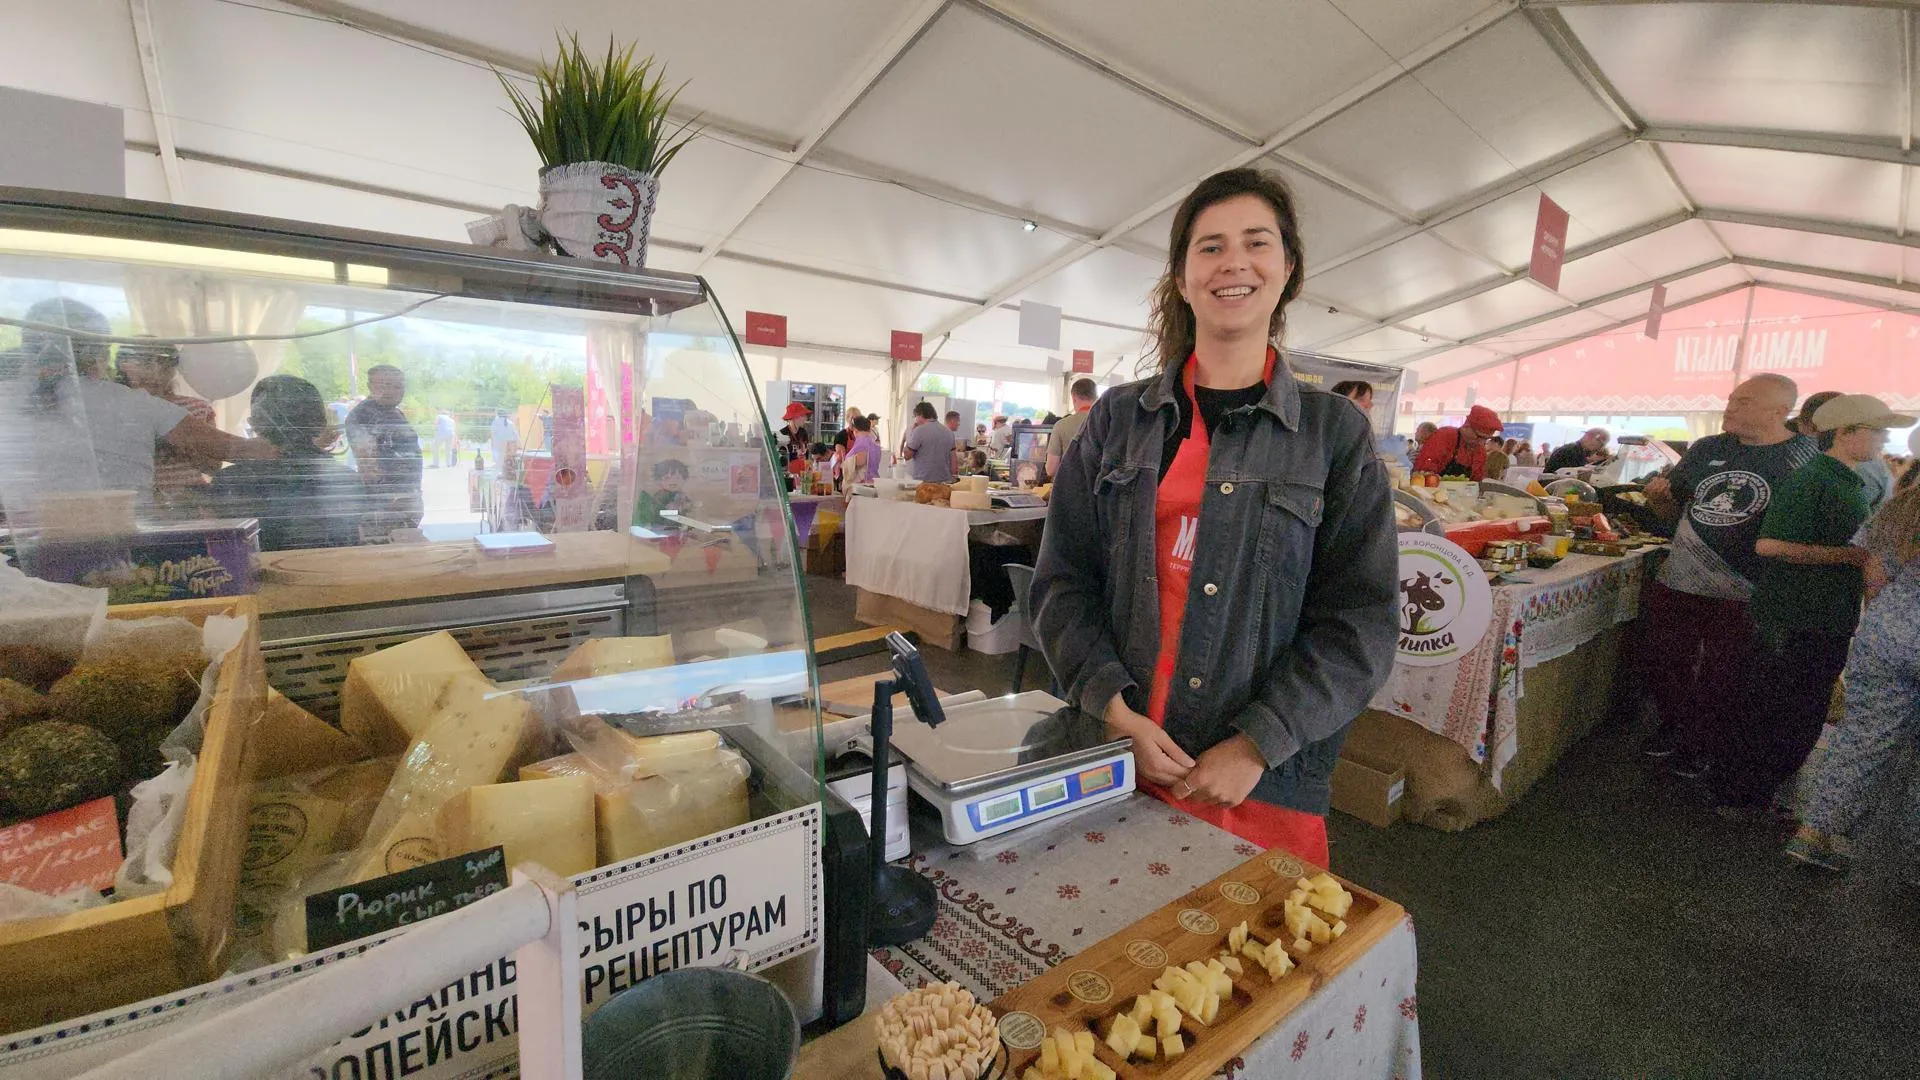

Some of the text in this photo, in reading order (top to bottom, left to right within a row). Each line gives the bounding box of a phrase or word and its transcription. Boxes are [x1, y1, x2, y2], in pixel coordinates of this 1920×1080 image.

[1414, 540, 1462, 566] ВОРОНЦОВА
[336, 881, 436, 925] Рюрик
[688, 874, 727, 919] ПО
[310, 894, 786, 1080] ОПЕЙСК РЕЦЕПТУРАМ
